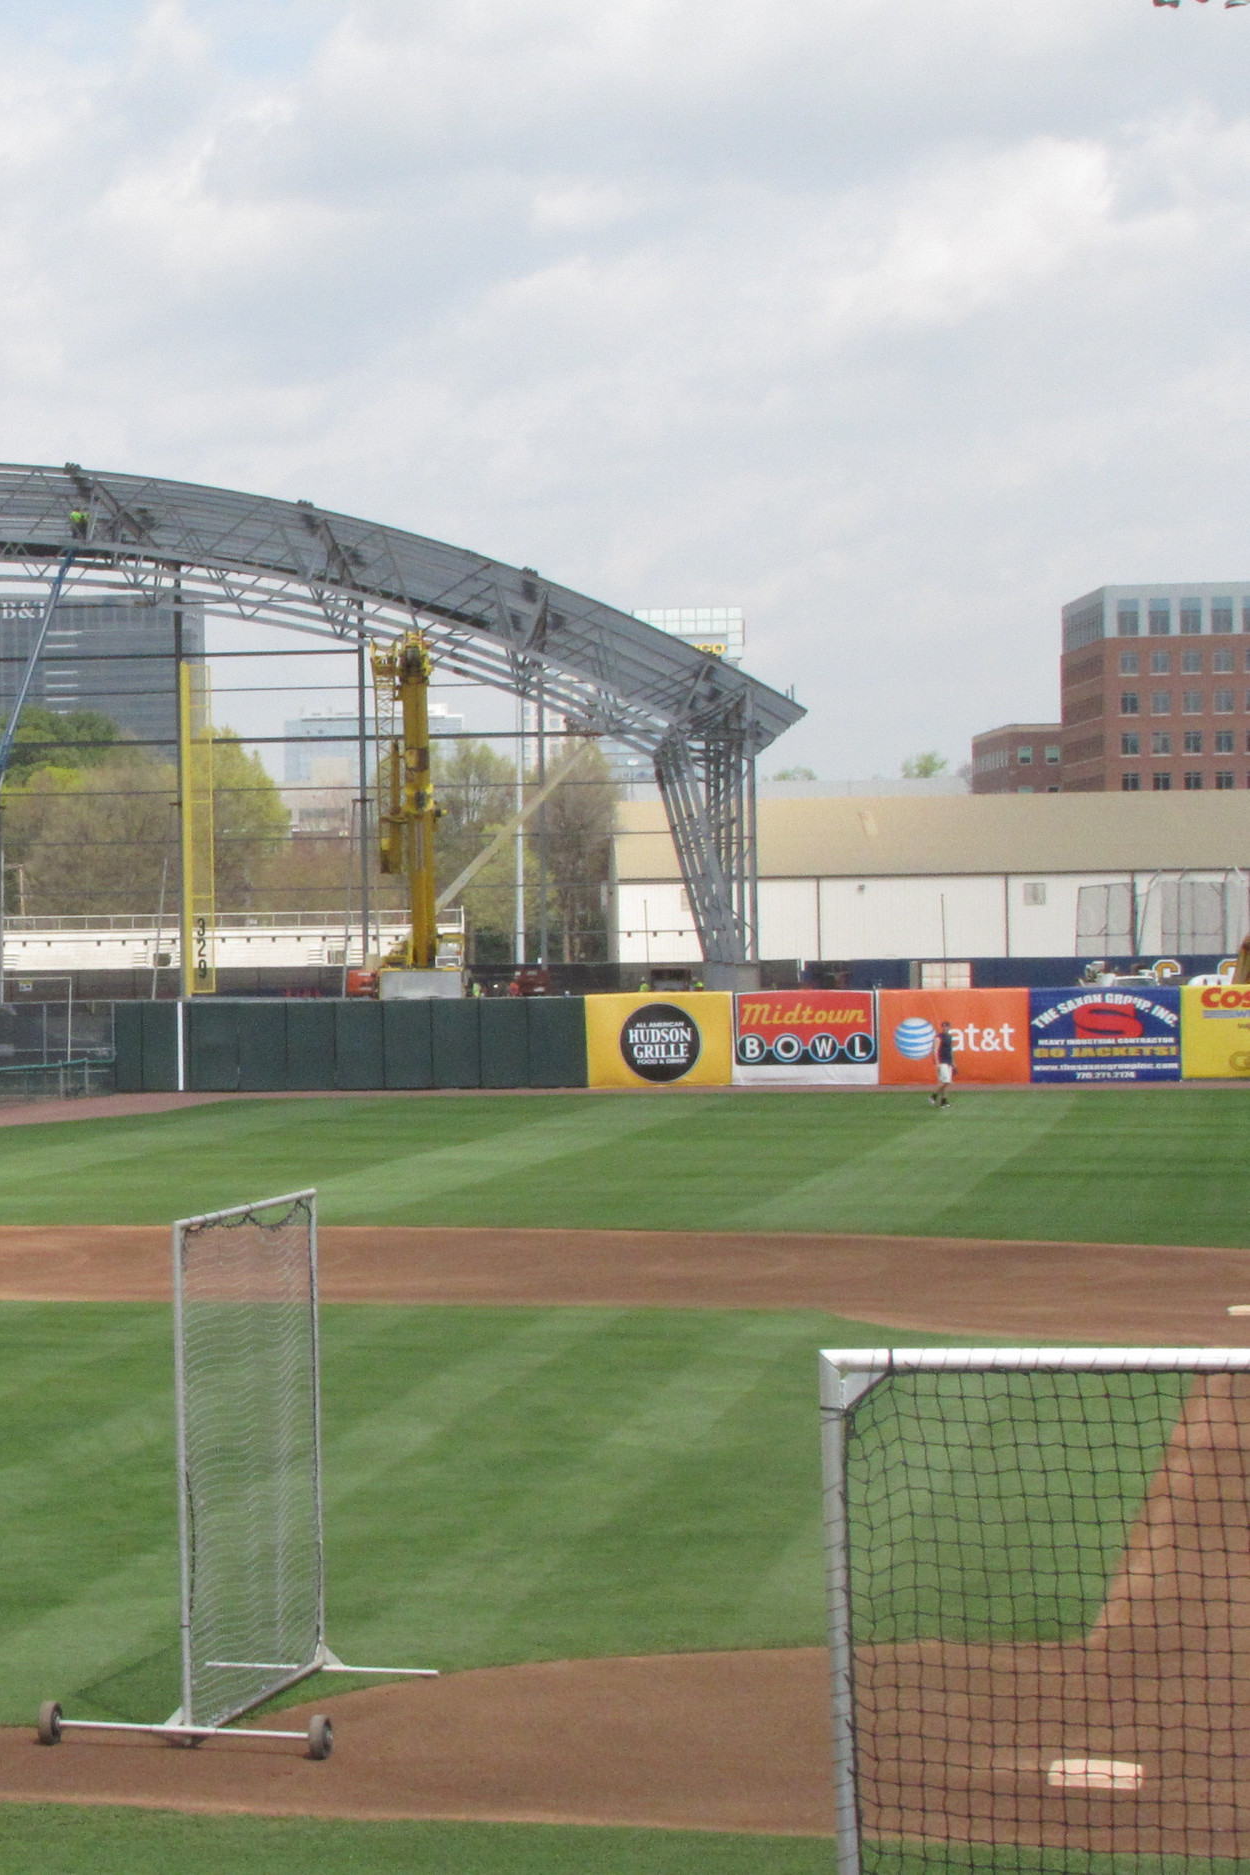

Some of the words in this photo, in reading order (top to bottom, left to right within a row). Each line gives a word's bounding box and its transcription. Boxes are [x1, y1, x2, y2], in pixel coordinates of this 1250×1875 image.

[741, 1003, 867, 1025] Midtown
[1031, 1008, 1060, 1028] THE
[1056, 994, 1102, 1014] SAXON
[1151, 1005, 1179, 1027] INC.
[628, 1028, 692, 1043] HUDSON
[948, 1023, 1015, 1052] at&t
[633, 1043, 689, 1058] GRILLE
[745, 1037, 867, 1058] BOWL
[1033, 1048, 1066, 1058] GO
[1071, 1046, 1179, 1057] JACKETS!
[1033, 1063, 1179, 1071] www.thesaxongroupinc.com
